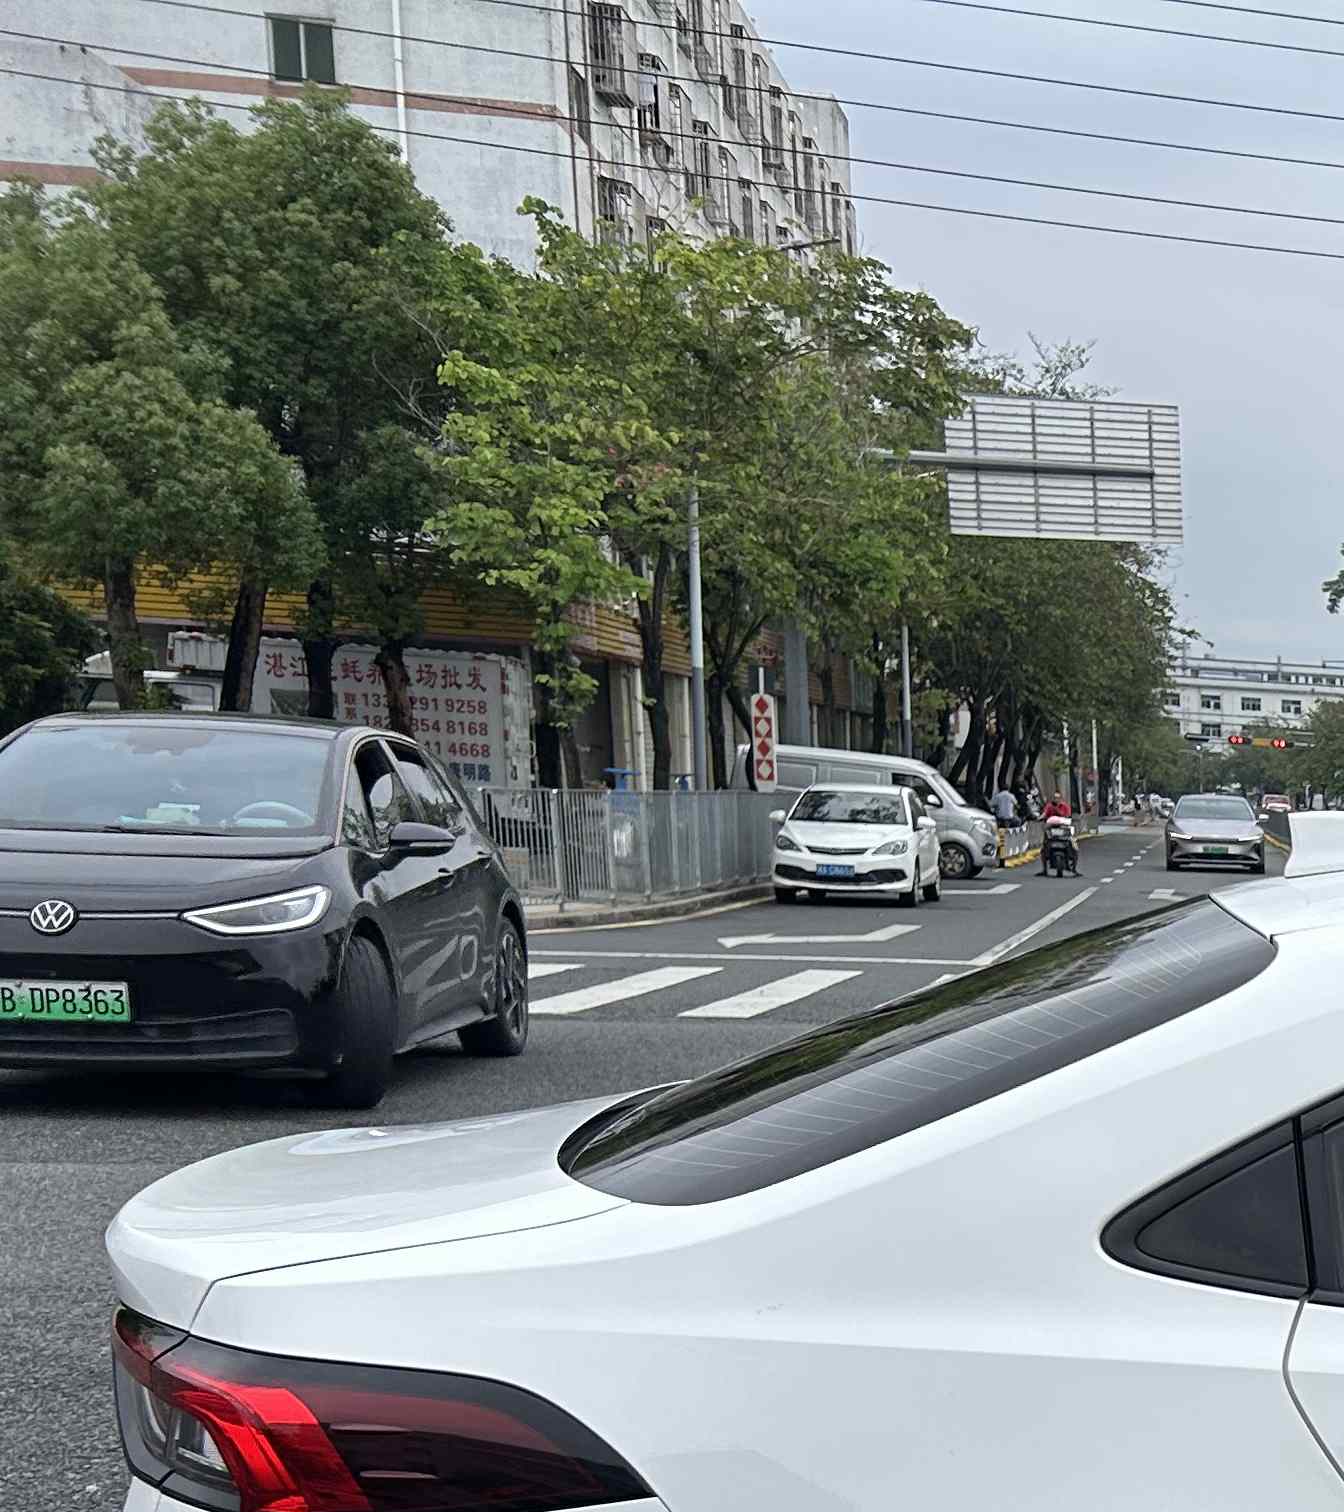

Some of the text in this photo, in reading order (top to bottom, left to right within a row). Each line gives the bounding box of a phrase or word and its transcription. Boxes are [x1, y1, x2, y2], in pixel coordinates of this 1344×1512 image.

[445, 698, 488, 714] 9258
[446, 720, 489, 736] 8168
[448, 742, 491, 758] 4668
